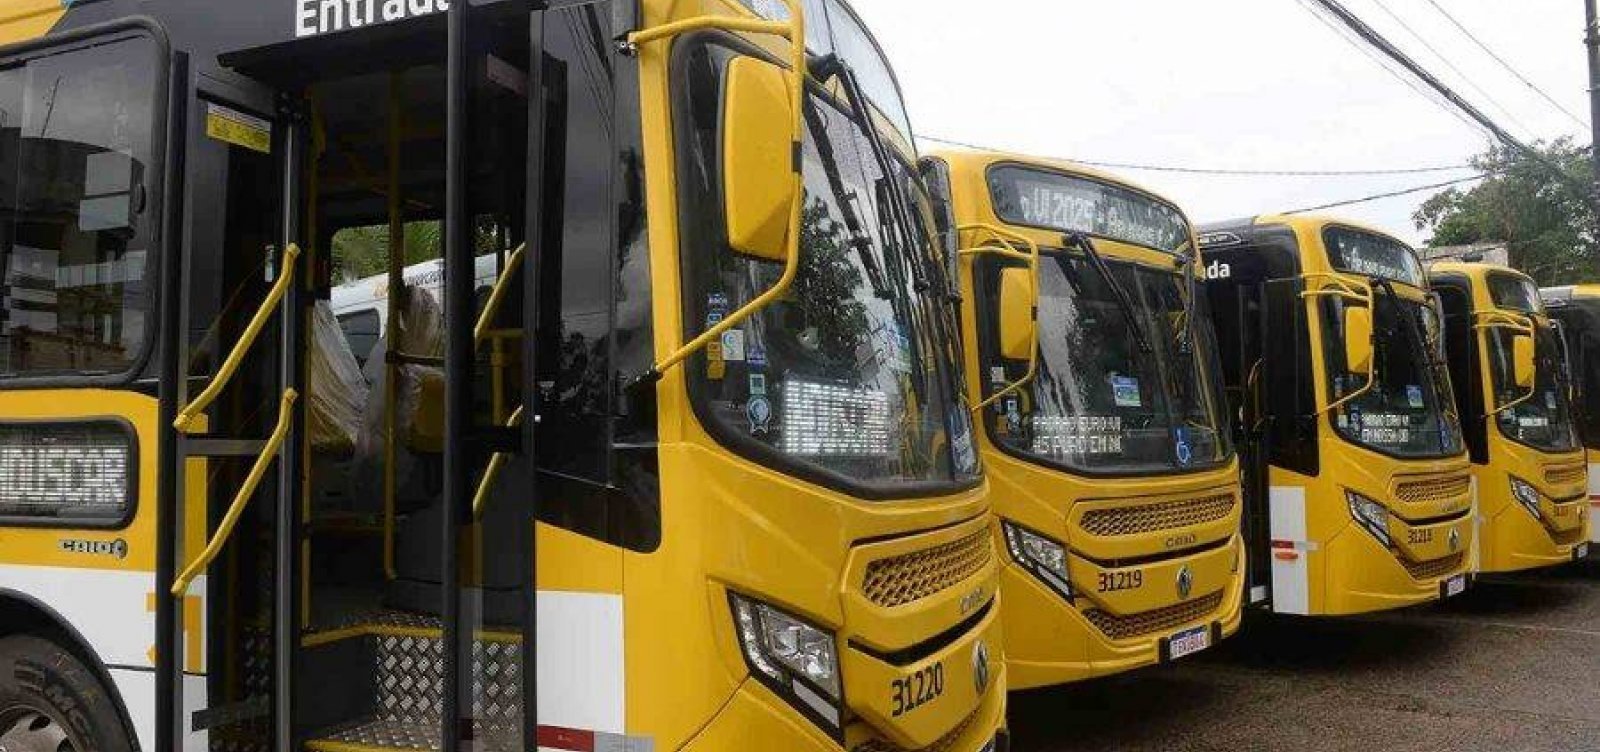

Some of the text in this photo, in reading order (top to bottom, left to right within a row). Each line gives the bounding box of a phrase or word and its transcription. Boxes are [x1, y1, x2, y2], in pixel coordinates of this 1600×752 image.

[1203, 260, 1231, 280] da
[1098, 569, 1142, 593] 31219
[891, 661, 944, 718] 31220
